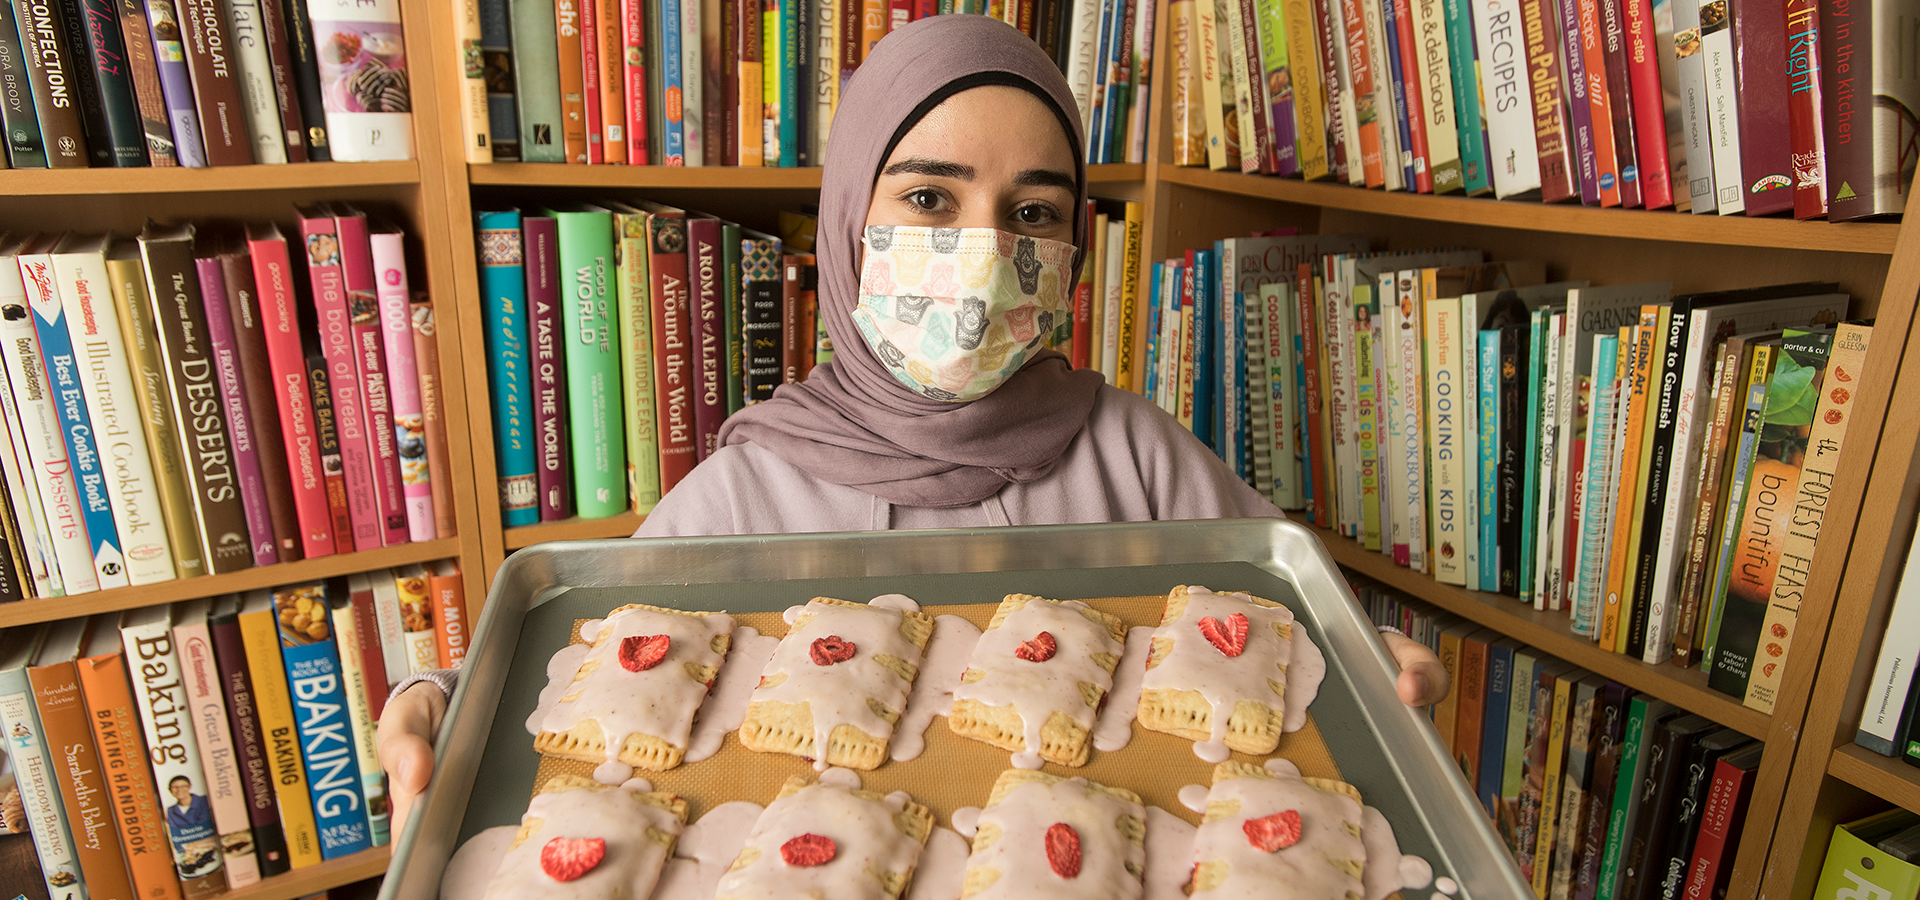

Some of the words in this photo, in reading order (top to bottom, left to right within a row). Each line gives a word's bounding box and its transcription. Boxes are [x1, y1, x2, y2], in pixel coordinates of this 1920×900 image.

[191, 11, 206, 54] Techniques
[1523, 0, 1545, 44] man
[1787, 5, 1817, 30] It
[1837, 21, 1854, 40] in
[32, 0, 69, 109] CONFECTIONS
[200, 0, 228, 78] CHOCOLATE
[1201, 12, 1216, 82] Holiday
[1530, 44, 1545, 59] &
[1567, 29, 1580, 71] RECIPES
[1712, 51, 1720, 67] Alex
[1837, 44, 1855, 74] the
[1173, 16, 1189, 122] appetizers
[1489, 10, 1518, 113] RECIPES
[1714, 68, 1722, 90] Barker
[1785, 27, 1820, 97] Right
[4, 73, 22, 113] BRODY
[1532, 51, 1560, 116] Polish
[1572, 72, 1585, 99] 2009
[1297, 66, 1315, 147] COOKBOOK
[1687, 87, 1697, 122] CHRISTINE
[1716, 95, 1725, 114] Sally
[1838, 78, 1855, 145] kitchen
[1719, 114, 1728, 148] Mansfield
[268, 262, 285, 292] good
[595, 256, 607, 297] FOOD
[1125, 220, 1138, 296] ARMENIAN
[75, 279, 89, 295] Good
[172, 272, 182, 293] The
[320, 271, 338, 302] the
[678, 286, 687, 310] The
[699, 240, 716, 321] AROMAS
[79, 295, 98, 336] Housekeeping
[125, 282, 146, 351] WILLIAMS-SONOMA
[174, 293, 188, 320] Great
[238, 290, 253, 329] desserts
[275, 292, 290, 334] cooking
[385, 294, 406, 333] 1000
[536, 301, 551, 314] A
[575, 265, 596, 345] WORLD
[597, 300, 608, 321] OF
[630, 286, 644, 338] AFRICA
[663, 273, 685, 350] Around
[1080, 288, 1090, 324] SPAIN
[1106, 285, 1120, 350] Mexican
[180, 321, 197, 343] Book
[326, 308, 349, 357] book
[537, 317, 554, 360] TASTE
[598, 324, 610, 353] THE
[1120, 297, 1134, 374] COOKBOOK
[1267, 294, 1283, 358] COOKING
[1437, 311, 1449, 365] FamilyFun
[1670, 313, 1685, 348] How
[1838, 341, 1867, 352] GLEESON
[1846, 333, 1862, 342] ERIN
[185, 344, 198, 354] of
[362, 331, 379, 372] best-ever
[1402, 338, 1414, 374] QUICK
[1483, 347, 1494, 366] Fun
[1637, 330, 1652, 371] Edible
[1667, 351, 1678, 368] to
[1784, 343, 1807, 352] porter
[53, 354, 72, 387] Best
[85, 339, 129, 437] Illustrated
[219, 349, 239, 395] FROZEN
[311, 369, 331, 405] CAKE
[334, 362, 353, 381] of
[500, 296, 521, 450] mediterranean
[540, 363, 554, 384] OF
[634, 353, 650, 406] MIDDLE
[666, 354, 684, 385] the
[702, 333, 719, 406] ALEPPO
[1271, 366, 1283, 400] KIDS
[1306, 369, 1316, 388] Fun
[1482, 366, 1494, 393] Stuff
[1634, 373, 1646, 396] Art
[1723, 354, 1736, 386] CHINESE
[61, 388, 81, 422] Ever
[366, 372, 388, 413] PASTRY
[422, 374, 437, 421] BAKING
[542, 387, 557, 416] THE
[1306, 390, 1318, 414] Food
[1358, 384, 1374, 417] kids
[1404, 384, 1415, 411] EASY
[1658, 371, 1678, 429] Garnish
[1715, 386, 1731, 427] GARNISHES
[180, 357, 235, 503] DESSERTS
[228, 398, 250, 452] DESSERTS
[286, 373, 306, 434] Delicious
[296, 436, 318, 490] Desserts
[317, 408, 337, 450] BALLS
[338, 387, 362, 440] bread
[637, 408, 652, 442] EAST
[668, 385, 688, 444] World
[1273, 402, 1284, 451] BIBLE
[1437, 370, 1453, 460] COOKING
[70, 424, 96, 471] Cookie
[374, 413, 393, 459] cookbook
[542, 417, 560, 471] WORLD
[1817, 438, 1838, 457] the
[1360, 422, 1377, 495] cookbook
[1404, 413, 1420, 505] COOKBOOK
[1441, 464, 1451, 485] with
[44, 459, 78, 540] Desserts
[82, 473, 108, 513] Book!
[110, 442, 150, 535] Cookbook
[1790, 468, 1835, 547] FOREST
[1440, 489, 1454, 532] KIDS
[1698, 501, 1712, 536] ADORNOS
[1741, 474, 1788, 586] bountiful
[1692, 536, 1707, 563] CHINOS
[1772, 552, 1812, 618] FEAST
[1492, 658, 1506, 693] Pasta
[1718, 662, 1727, 670] &
[1726, 664, 1747, 679] chang
[1722, 650, 1748, 663] stewart
[1724, 656, 1744, 669] tabori
[1888, 657, 1902, 685] Publications
[135, 630, 188, 766] Baking
[1753, 684, 1775, 695] stewart
[1754, 689, 1771, 699] tabori
[1879, 685, 1894, 715] International,
[113, 706, 139, 771] MARTHA
[201, 703, 221, 744] Great
[1876, 715, 1884, 725] Ltd.
[271, 726, 300, 787] BAKING
[294, 674, 359, 819] BAKING
[63, 743, 98, 808] Sarabeth's
[96, 710, 124, 770] BAKING
[113, 774, 148, 856] HANDBOOK
[210, 746, 234, 799] Baking
[27, 755, 52, 814] HEIRLOOM
[44, 813, 63, 856] BAKING
[1703, 778, 1723, 825] GOURMET
[1713, 780, 1733, 832] PRACTICAL
[80, 806, 107, 851] Bakery
[1687, 857, 1710, 900] Inviting
